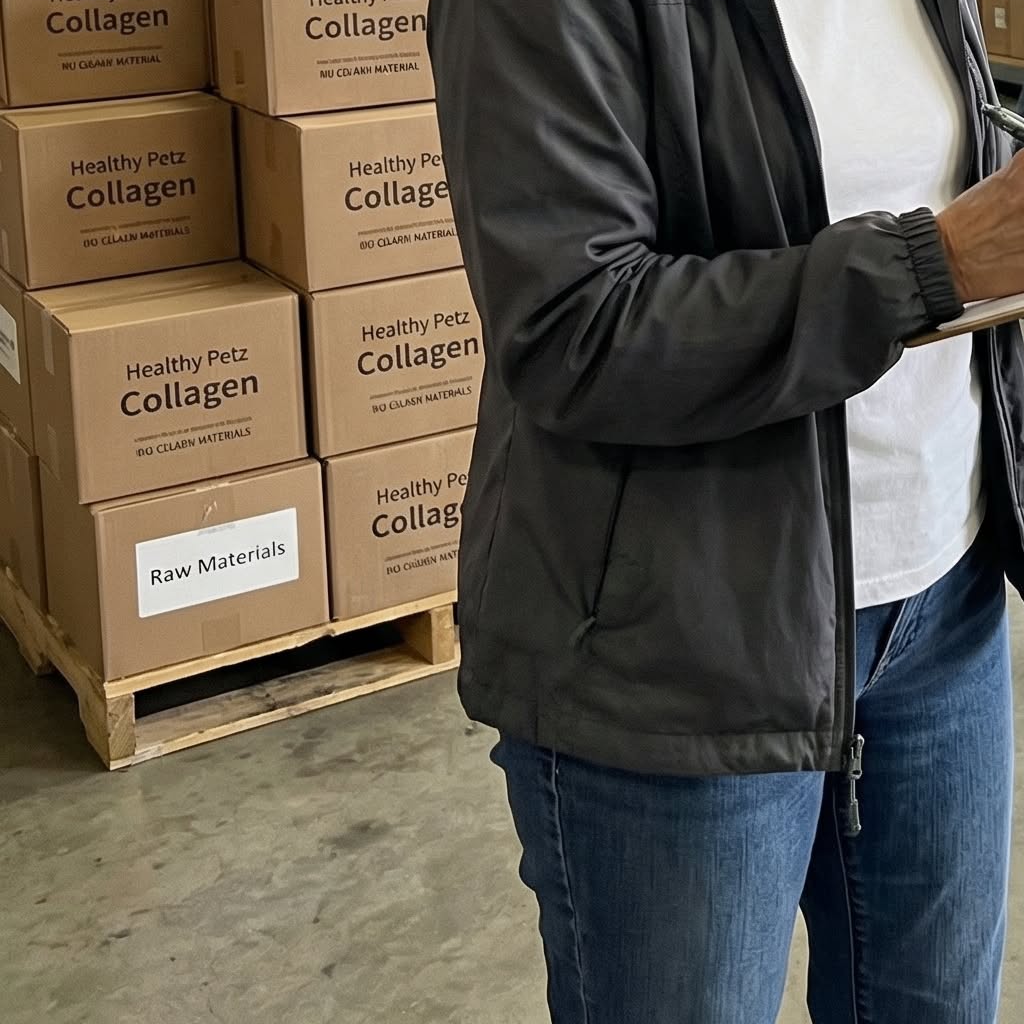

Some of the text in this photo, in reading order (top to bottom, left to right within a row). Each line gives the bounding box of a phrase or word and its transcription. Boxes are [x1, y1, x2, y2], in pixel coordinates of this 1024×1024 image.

[46, 7, 169, 35] Collagen
[305, 12, 426, 41] Collagen
[71, 151, 187, 176] Healthy Petz
[349, 152, 442, 178] Healthy Pe
[66, 176, 196, 210] Collagen
[344, 180, 449, 212] Collage
[362, 311, 470, 342] Healthy Petz
[126, 347, 249, 381] Healthy Petz
[357, 336, 479, 376] Collagen
[120, 374, 259, 417] Collagen
[376, 472, 468, 506] Healthy Pe
[371, 502, 460, 538] Collag
[150, 540, 286, 586] Raw Materials
